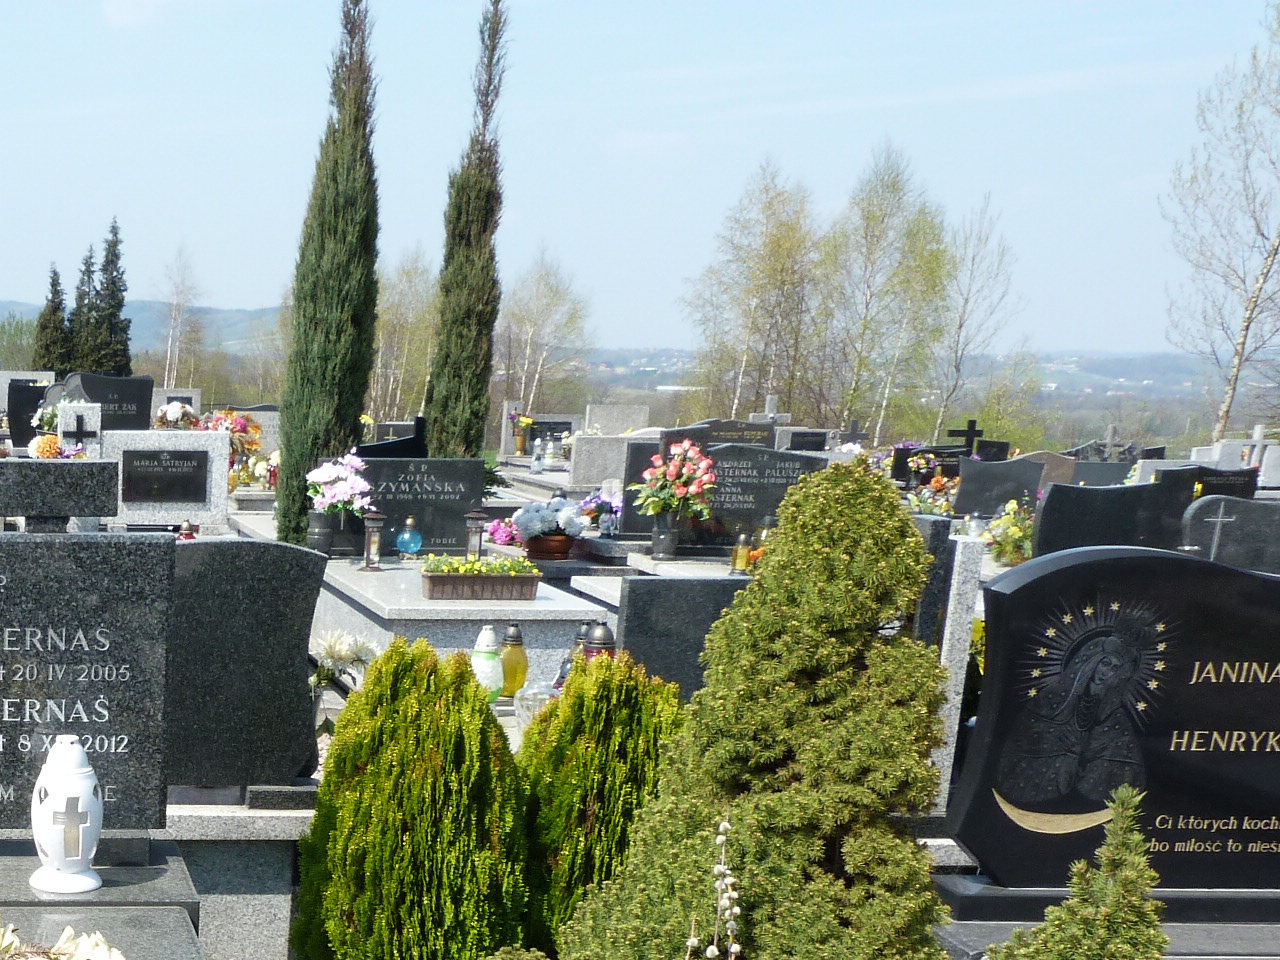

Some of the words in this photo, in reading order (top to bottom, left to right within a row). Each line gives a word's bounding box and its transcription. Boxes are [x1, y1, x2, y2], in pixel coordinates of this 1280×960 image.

[397, 473, 436, 481] ZOFIA
[710, 494, 755, 502] ASTERNAK
[12, 664, 38, 682] 20
[47, 664, 67, 681] IV
[76, 664, 131, 682] 2005
[17, 733, 31, 752] 8
[80, 734, 130, 753] 2012
[1177, 815, 1238, 833] których
[1242, 815, 1280, 830] koch
[1174, 838, 1223, 852] miłość
[1227, 838, 1243, 852] to
